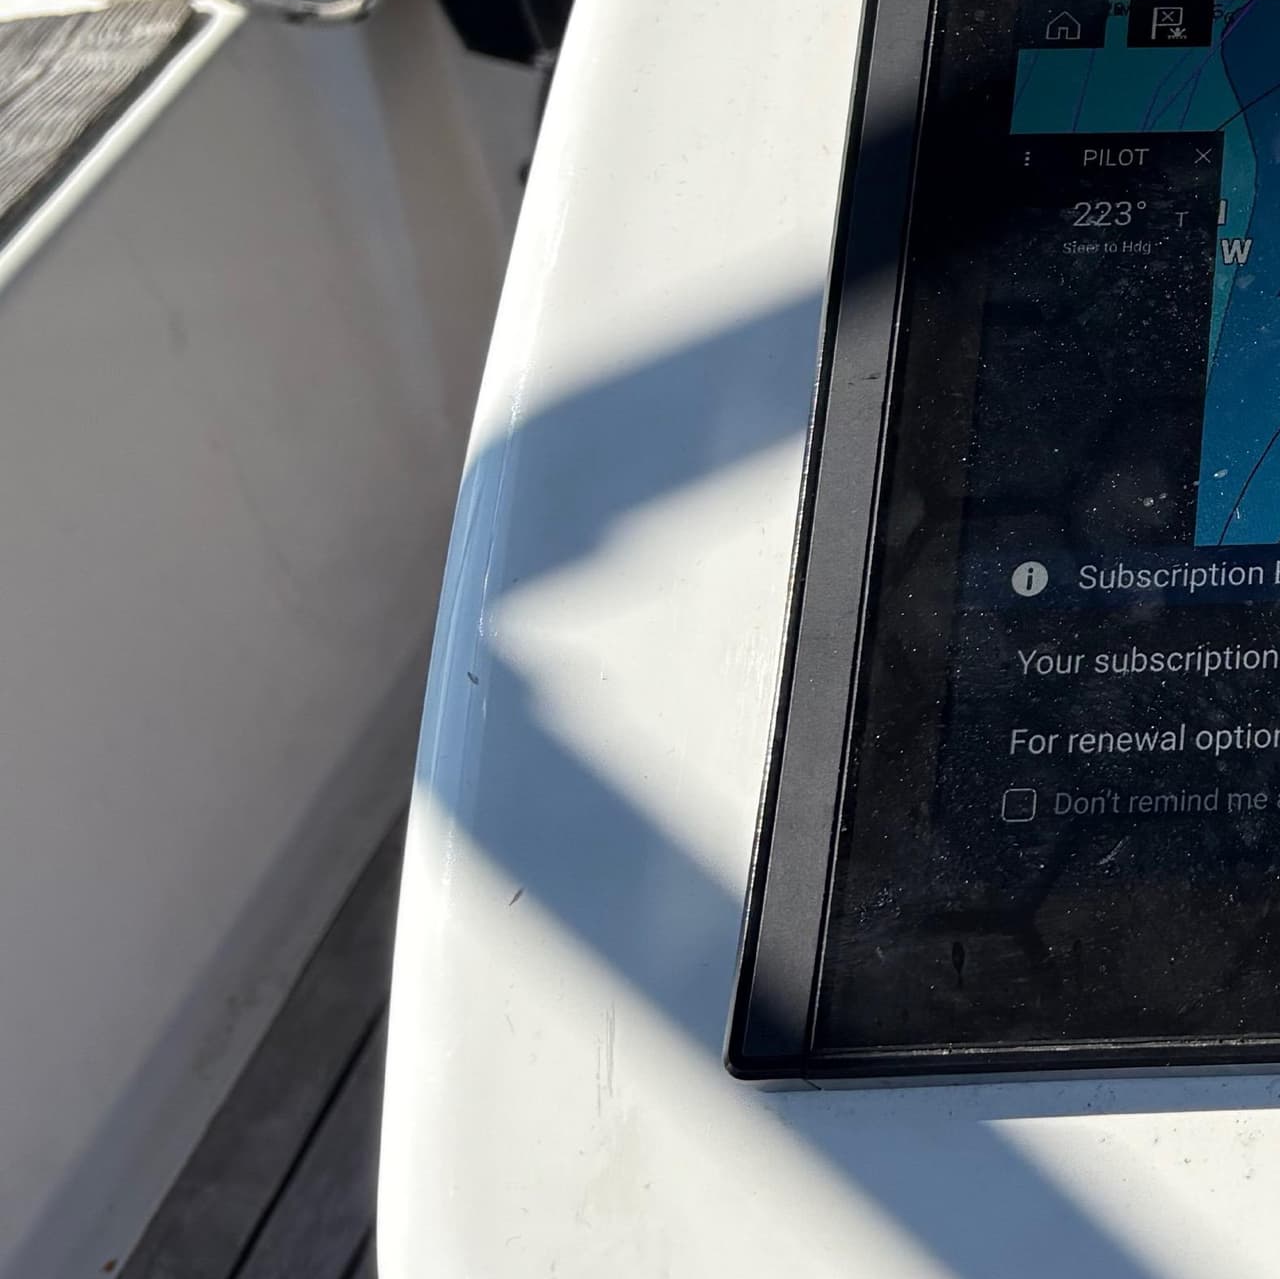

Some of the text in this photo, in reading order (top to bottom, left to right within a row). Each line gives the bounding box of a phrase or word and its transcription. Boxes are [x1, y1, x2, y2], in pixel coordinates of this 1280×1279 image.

[1083, 149, 1149, 167] PILOT
[1073, 201, 1189, 226] 223° T
[1104, 240, 1117, 253] to
[1122, 240, 1152, 256] Hdg
[1221, 240, 1252, 264] W
[1079, 558, 1264, 593] Subscription
[1018, 649, 1084, 676] Your
[1094, 642, 1278, 676] subscription
[1010, 728, 1060, 754] For
[1068, 724, 1185, 752] renewal
[1054, 790, 1120, 816] Don't
[1129, 789, 1219, 813] remind
[1227, 792, 1269, 811] me
